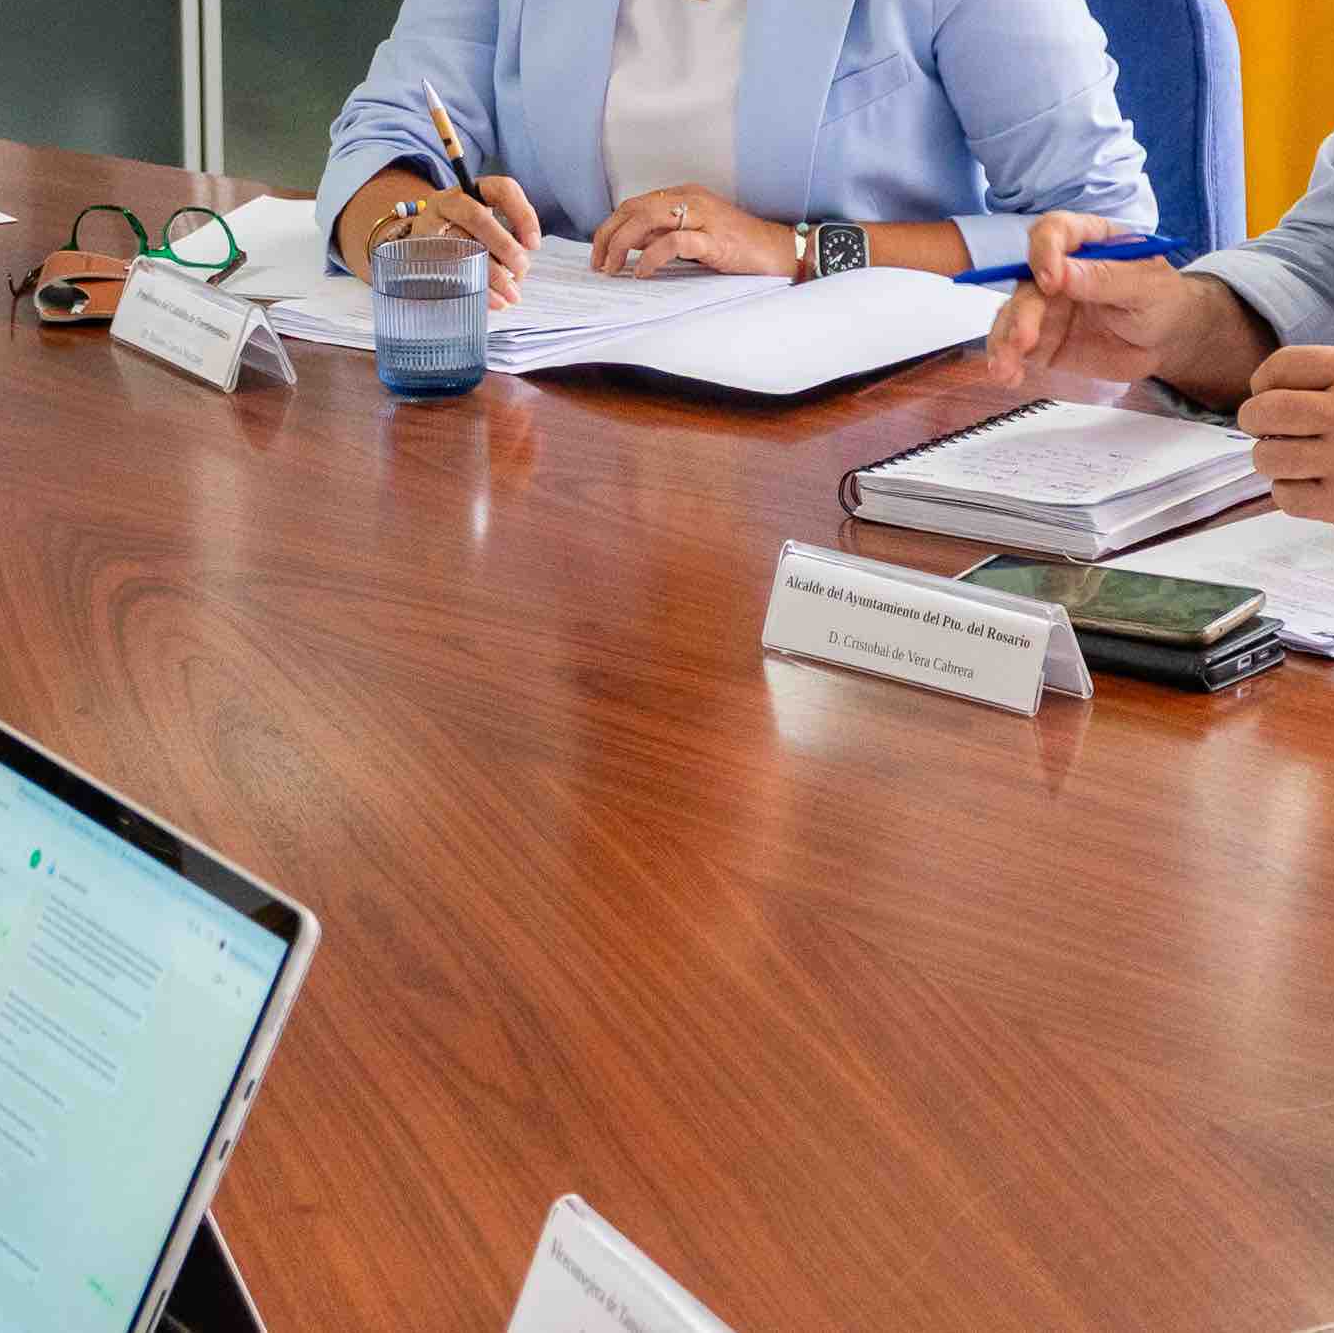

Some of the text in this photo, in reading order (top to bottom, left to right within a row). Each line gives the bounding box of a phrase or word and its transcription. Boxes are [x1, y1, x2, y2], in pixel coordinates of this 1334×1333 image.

[785, 574, 1032, 649] Alcalde del Ayuntamiento del Pto. del Rosario
[828, 630, 842, 645] D.
[891, 648, 905, 661] de
[907, 651, 931, 668] Vera
[933, 657, 974, 679] Cabrera
